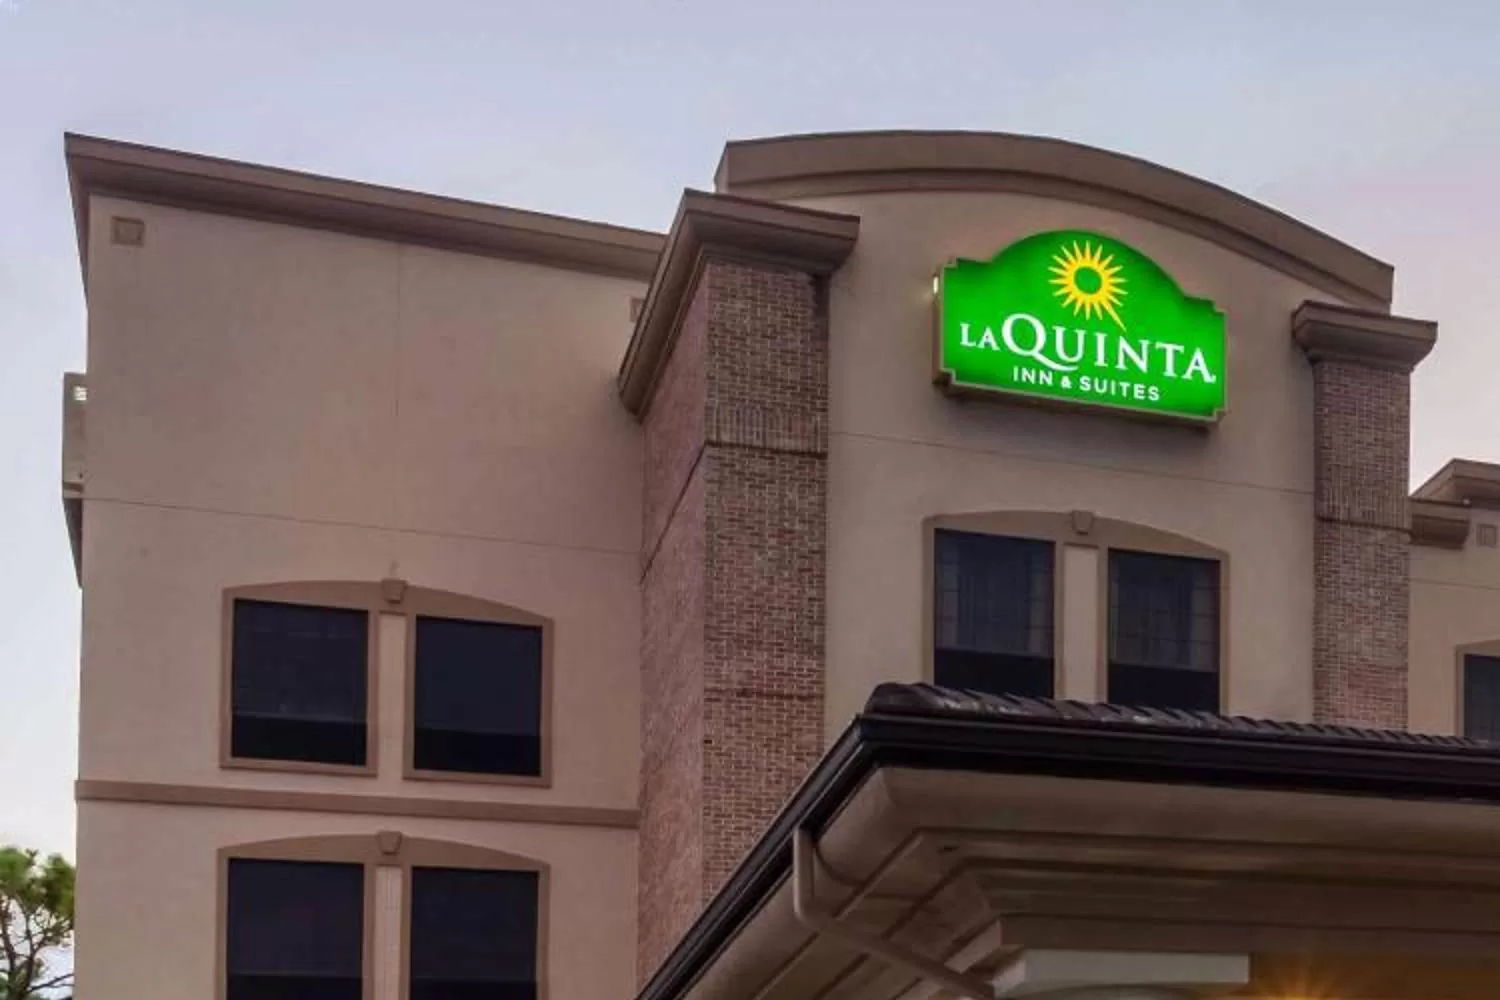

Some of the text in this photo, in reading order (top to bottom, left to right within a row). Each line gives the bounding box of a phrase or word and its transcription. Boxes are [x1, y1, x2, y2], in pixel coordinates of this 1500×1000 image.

[960, 313, 1217, 384] LA QUINTA
[1012, 365, 1160, 401] INN & SUITES
